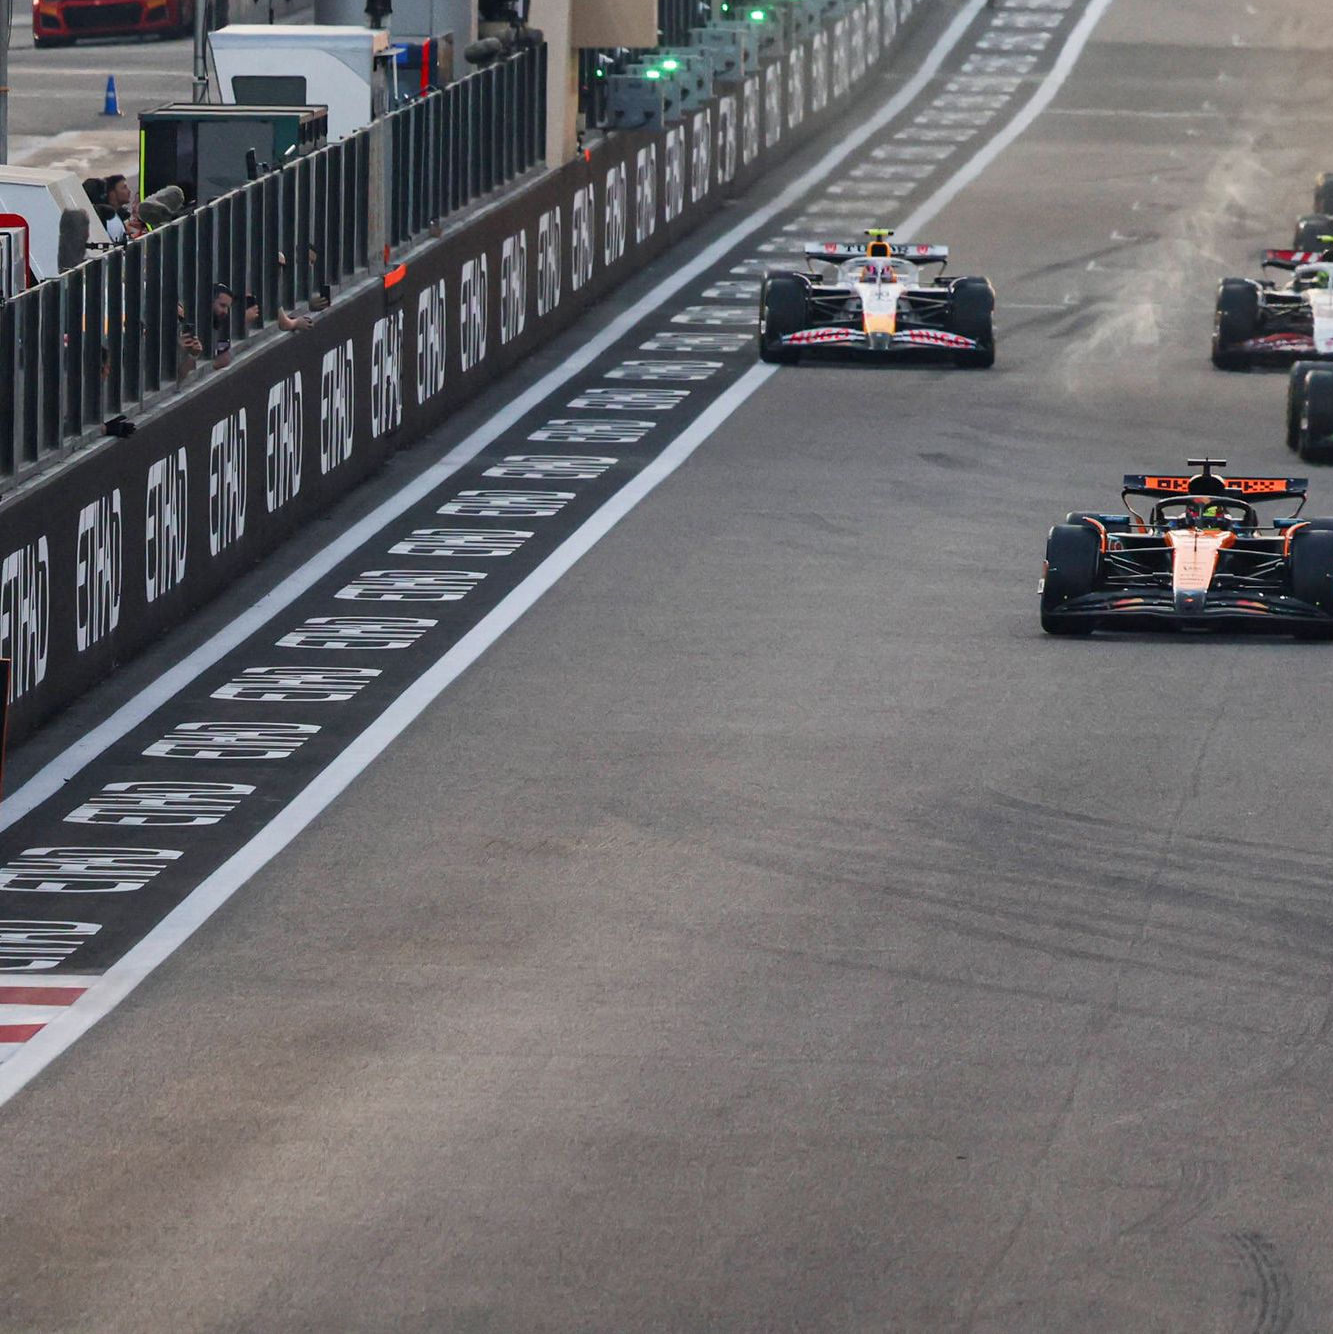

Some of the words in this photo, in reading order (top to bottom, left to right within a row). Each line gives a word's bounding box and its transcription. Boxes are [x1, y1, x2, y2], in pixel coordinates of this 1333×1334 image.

[417, 278, 446, 405] ETIHAD
[266, 370, 303, 513] ETIHAD
[320, 338, 354, 475] ETIHAD
[146, 446, 188, 602] ETIHAD
[209, 407, 247, 556] ETIHAD
[76, 488, 122, 652] ETIHAD
[274, 616, 440, 649] ETIHAD
[333, 570, 489, 601] ETIHAD
[141, 722, 322, 759] ETIHAD
[209, 666, 383, 702] ETIHAD
[63, 781, 256, 826] ETIHAD
